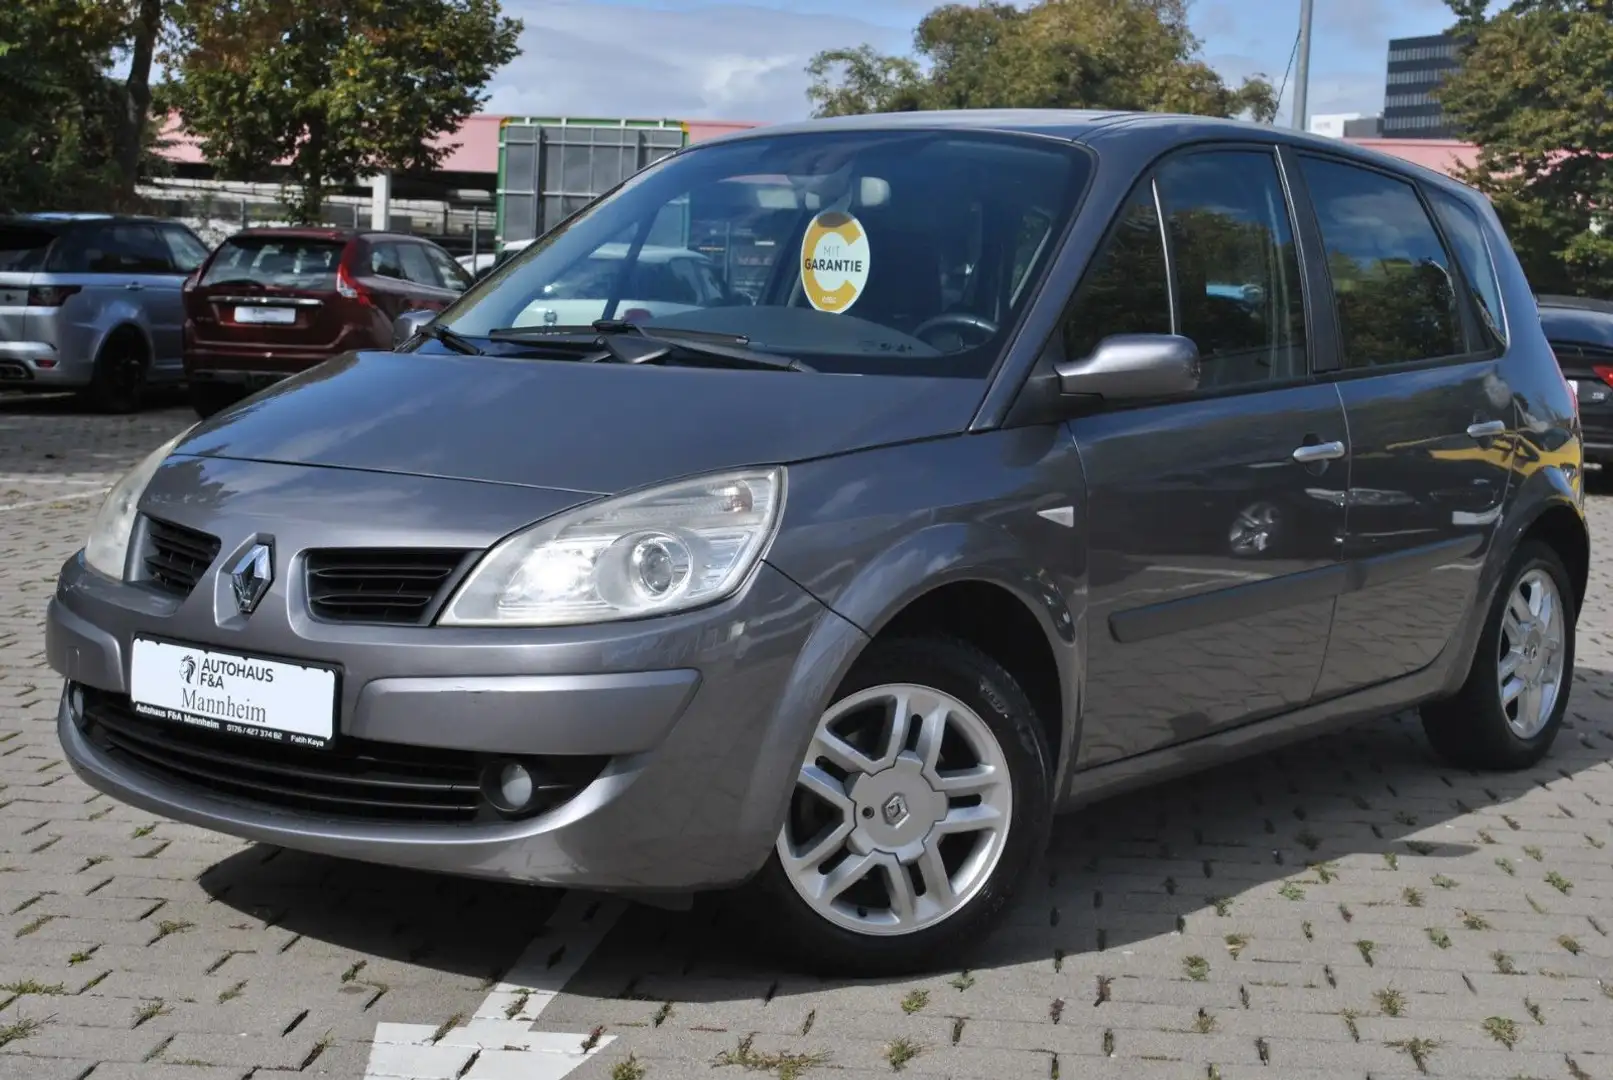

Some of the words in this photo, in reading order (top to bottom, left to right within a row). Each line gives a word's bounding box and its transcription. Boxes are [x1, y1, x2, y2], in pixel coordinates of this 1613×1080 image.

[823, 245, 841, 257] MIT
[804, 258, 863, 272] GARANTIE
[200, 672, 224, 690] F&A
[201, 658, 274, 683] AUTOHAUS
[135, 703, 167, 718] Autohaus
[167, 710, 182, 721] F&A
[183, 713, 220, 729] Mannheim
[181, 688, 267, 723] Mannheim
